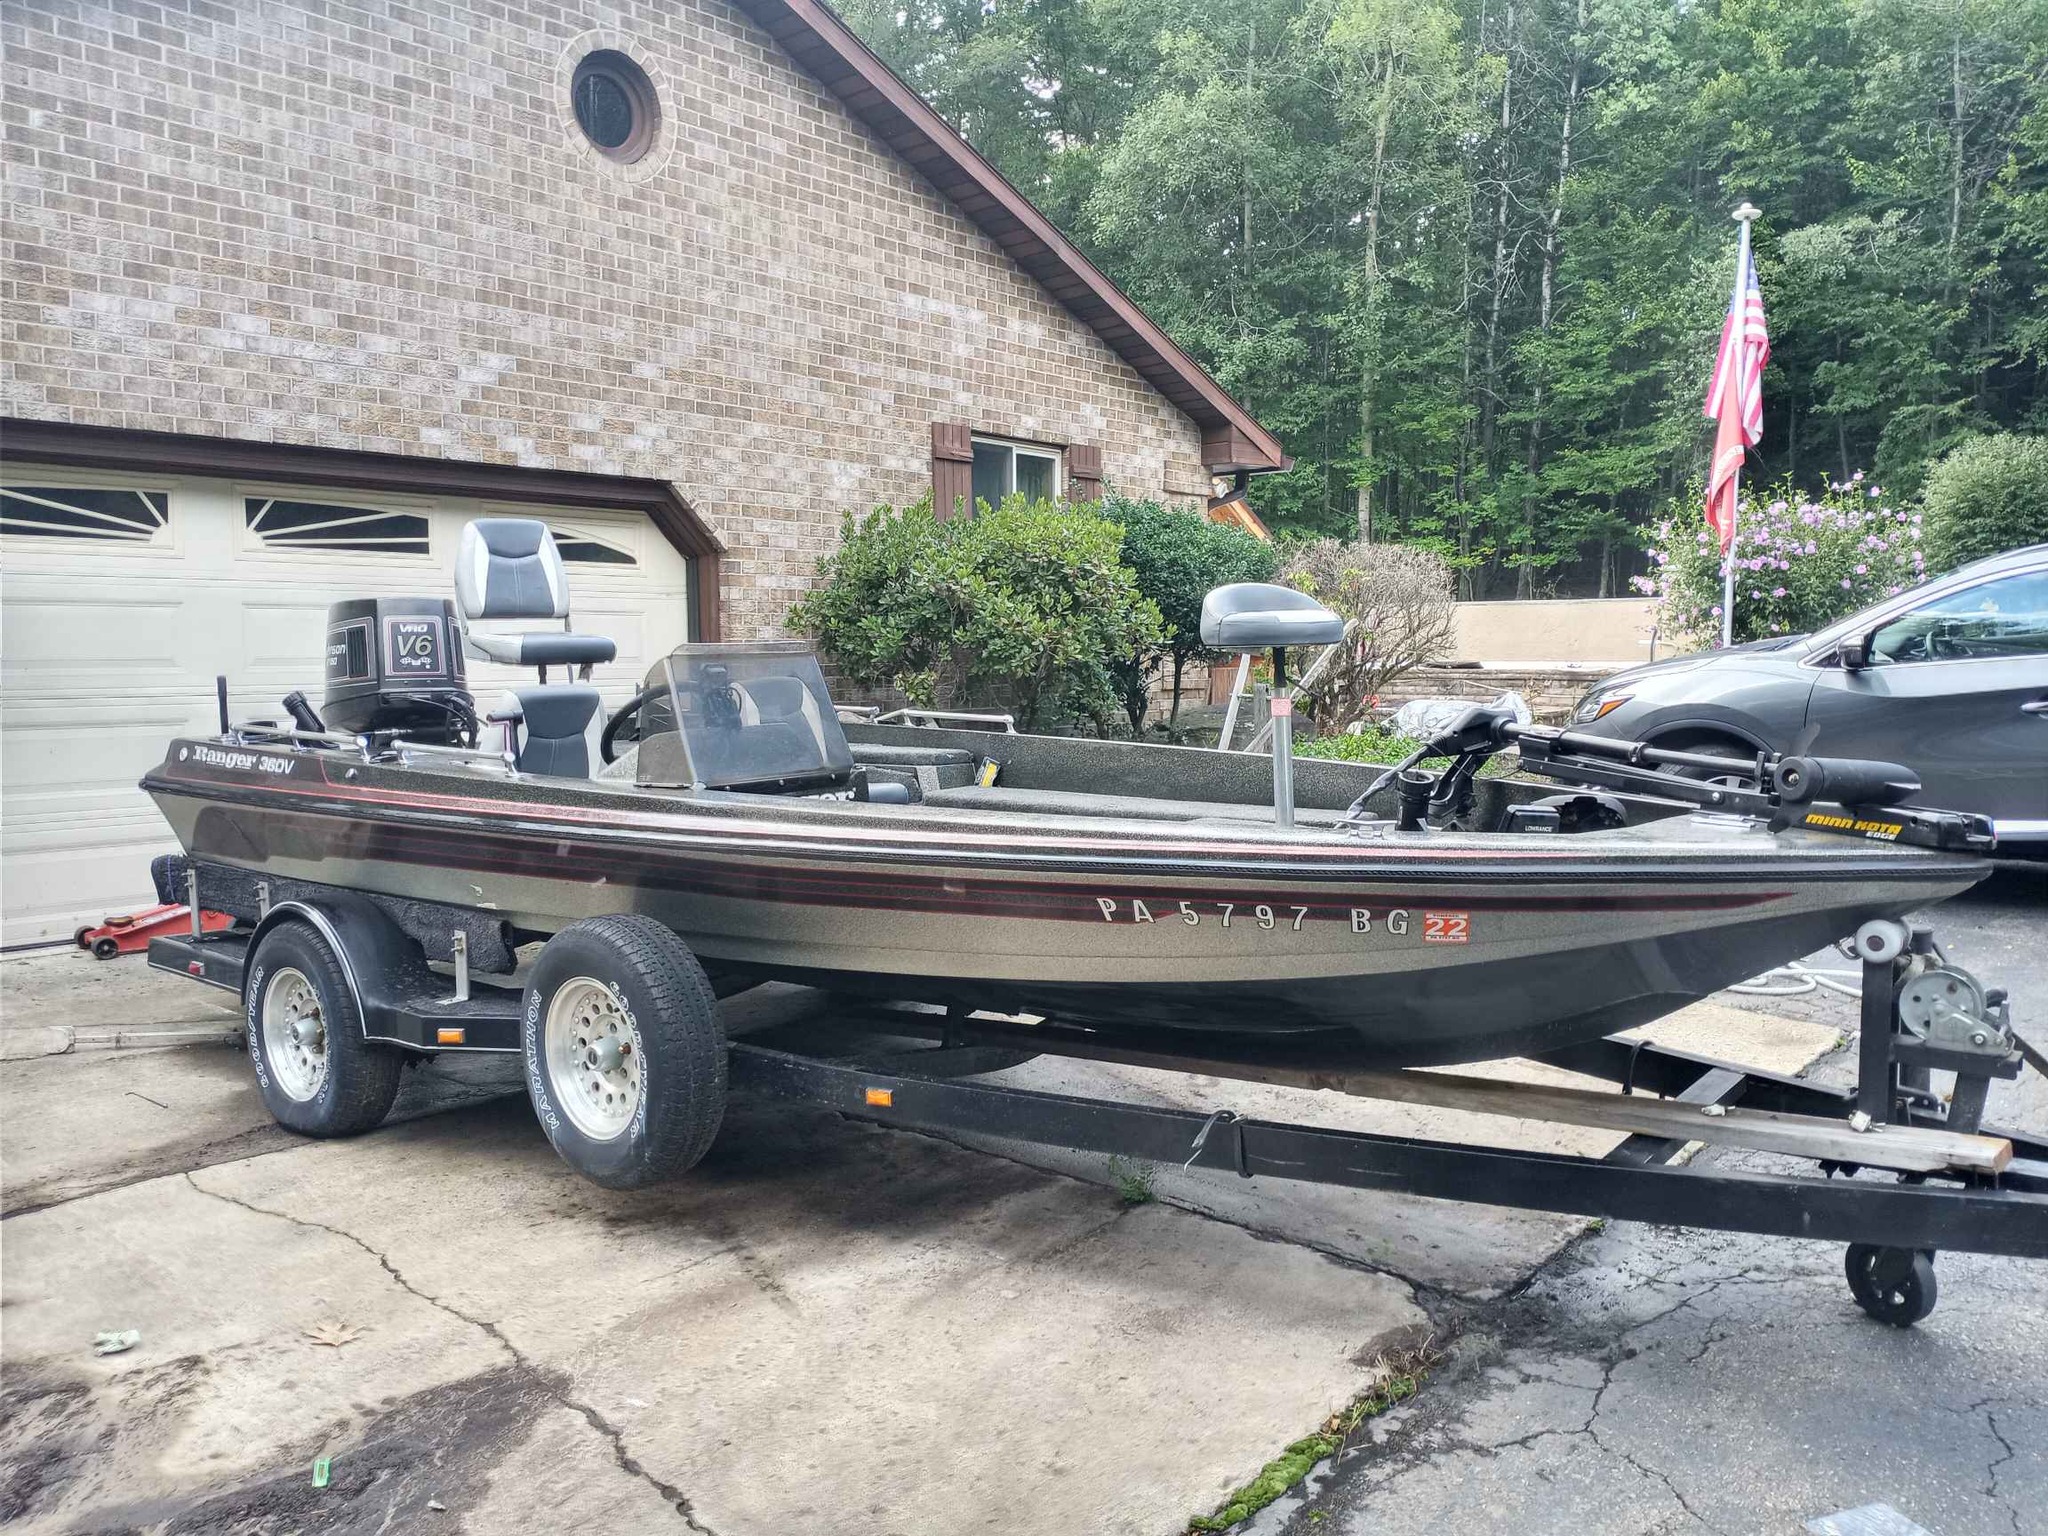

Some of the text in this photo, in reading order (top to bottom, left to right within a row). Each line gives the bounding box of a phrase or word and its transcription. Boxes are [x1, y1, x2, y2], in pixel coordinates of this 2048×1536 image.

[397, 635, 433, 656] V6
[193, 745, 258, 770] Ranger
[1854, 820, 1903, 835] KOTA
[1865, 830, 1898, 841] EDGE
[1096, 897, 1410, 935] PA 5797 BG
[1425, 918, 1467, 936] 22
[526, 989, 560, 1130] MARATHON
